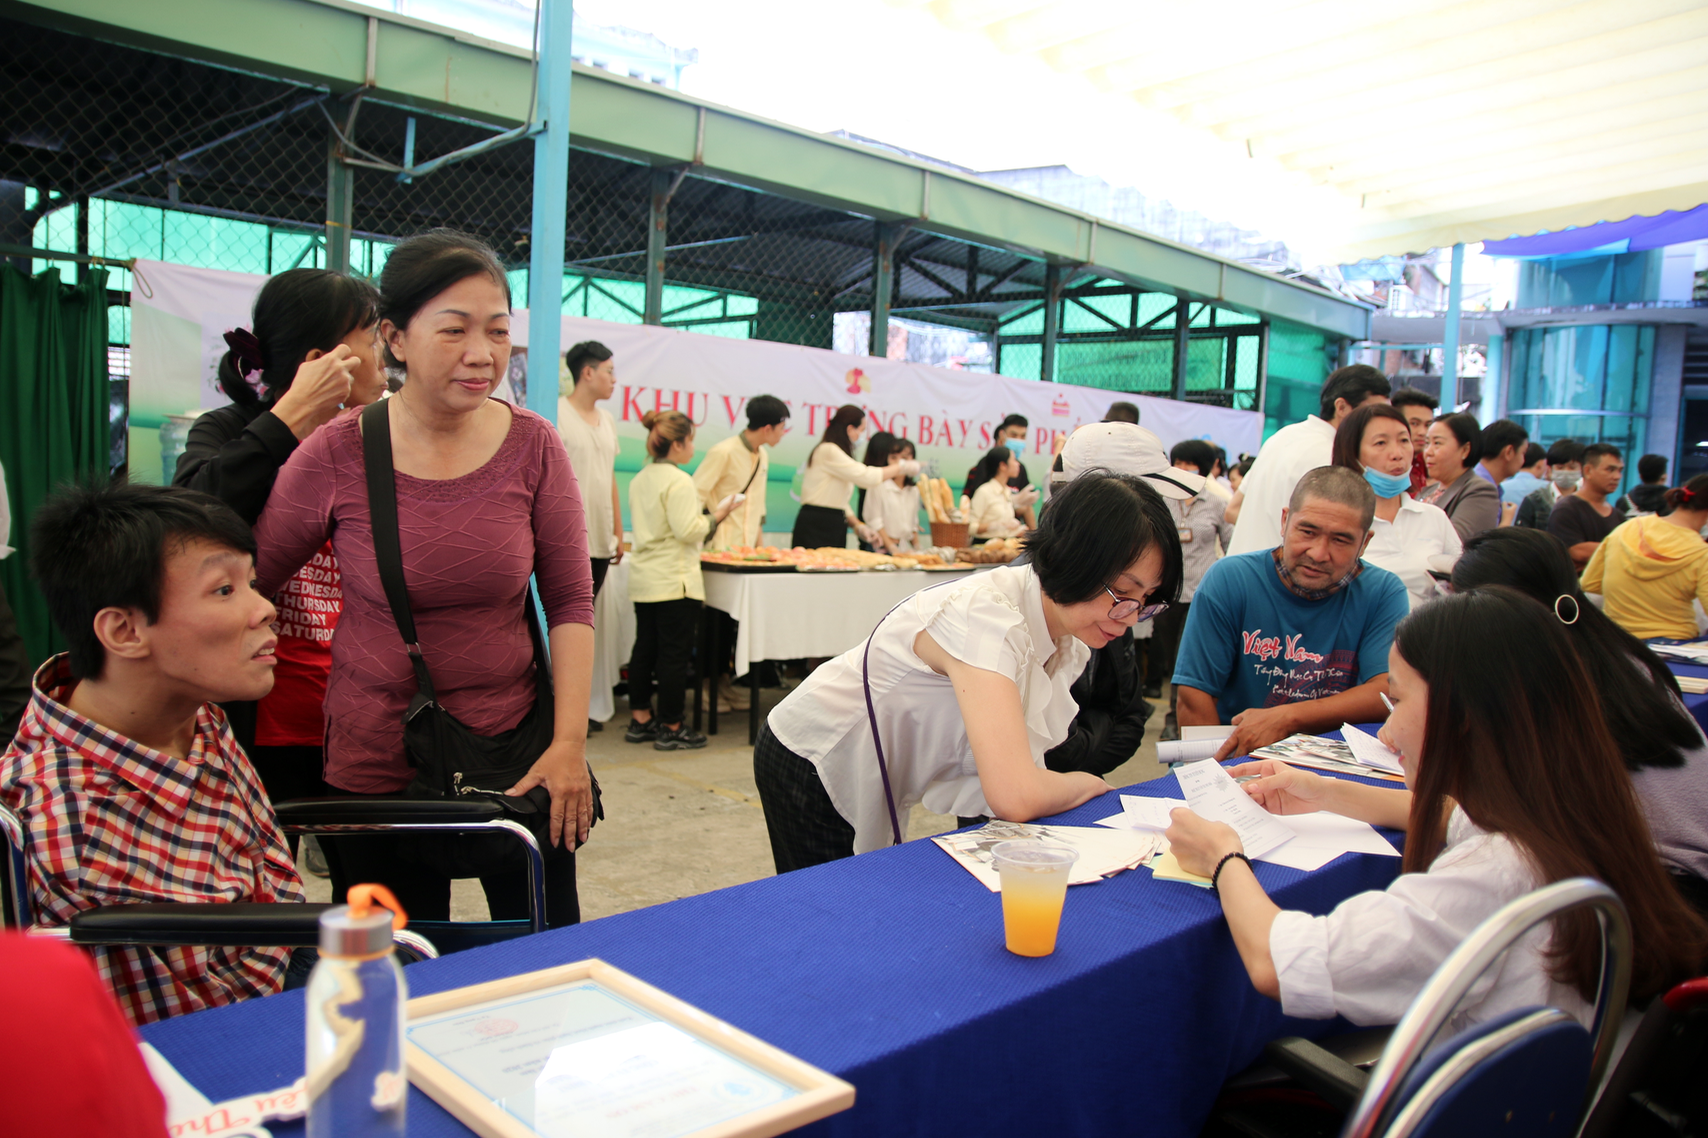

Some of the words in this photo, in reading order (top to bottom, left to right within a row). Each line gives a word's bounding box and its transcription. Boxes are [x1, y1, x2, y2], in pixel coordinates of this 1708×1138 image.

[918, 410, 973, 449] BÀY
[275, 593, 340, 613] THURSDAY
[1242, 629, 1283, 662] Việt
[1284, 633, 1324, 664] Nam
[255, 1077, 308, 1113] êu
